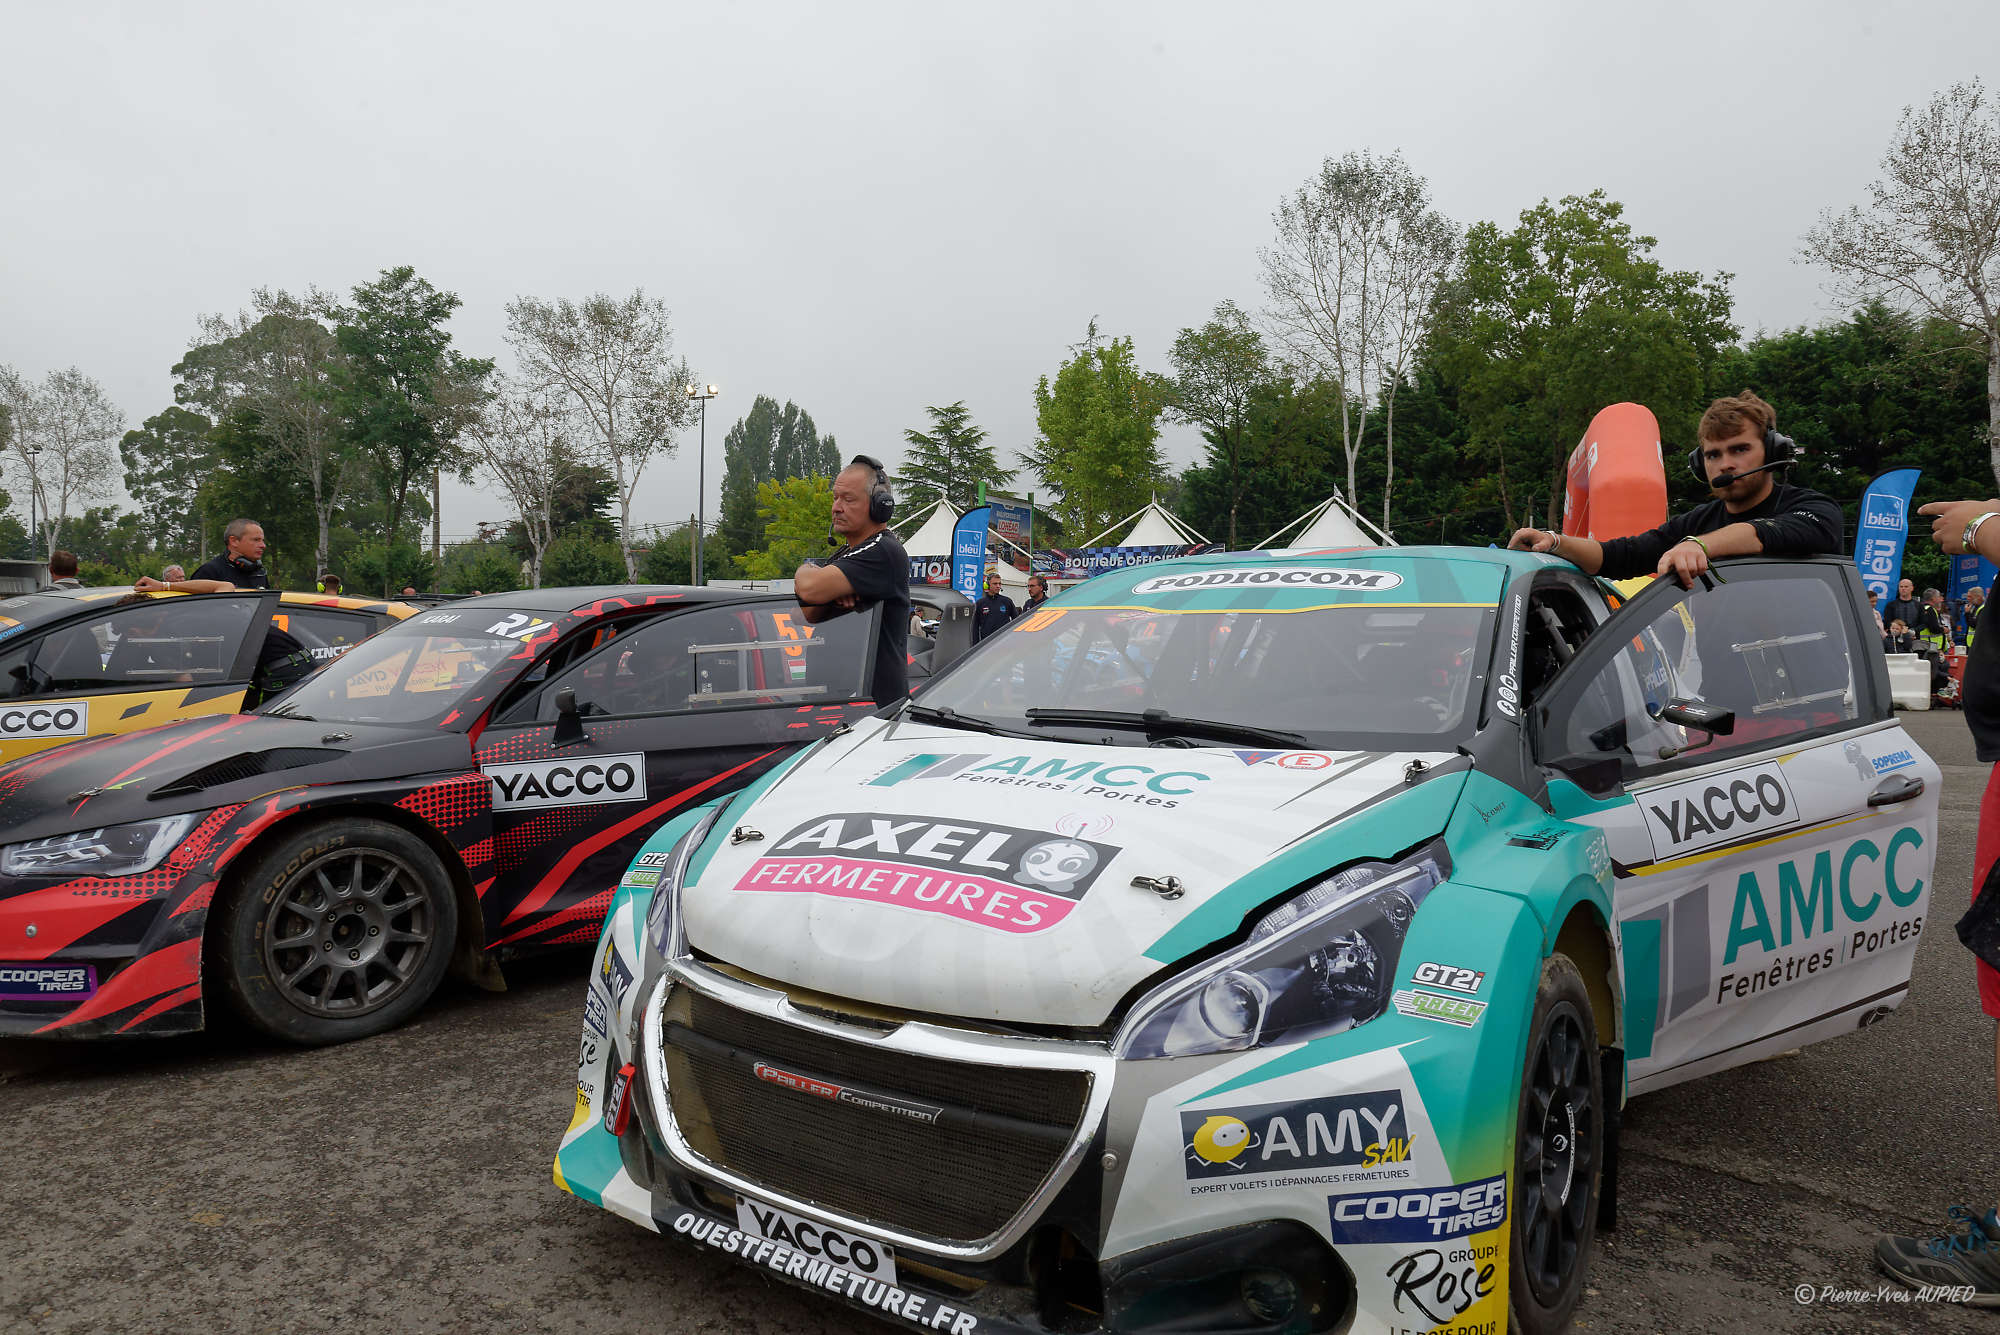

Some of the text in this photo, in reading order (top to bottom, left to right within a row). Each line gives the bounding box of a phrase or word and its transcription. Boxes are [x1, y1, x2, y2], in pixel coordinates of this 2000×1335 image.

[1065, 556, 1123, 568] BOUTIQUE
[1149, 571, 1384, 590] PODIOCOM
[1013, 611, 1068, 632] 10
[0, 708, 79, 736] CCO
[970, 756, 1211, 795] AMCC
[1872, 750, 1913, 769] SOPREMA
[492, 763, 636, 802] YACCO
[953, 773, 1179, 809] Fenêtres Portes
[1650, 773, 1786, 844] YACCO
[775, 819, 1011, 870] AXEL
[750, 863, 1050, 927] FERMETURES
[1722, 826, 1925, 966] AMCC
[0, 969, 86, 982] COOPER
[1415, 962, 1486, 991] GT2i
[1717, 916, 1923, 1005] Fenêtres Portes
[38, 981, 85, 991] TIRES
[1412, 995, 1483, 1018] GREEN
[577, 1080, 594, 1096] OUR
[1261, 1104, 1399, 1161] AMY
[1361, 1134, 1417, 1169] SAV
[1190, 1183, 1228, 1195] EXPERT
[1229, 1179, 1267, 1191] VOLETS
[1275, 1173, 1340, 1187] DÉPANNAGES
[1342, 1169, 1410, 1182] FERMETURES
[1333, 1178, 1506, 1222] COOPER
[1428, 1202, 1504, 1236] TIRES
[748, 1203, 880, 1274] YACCO
[1448, 1245, 1498, 1263] GROUPE
[673, 1212, 978, 1335] OUESTFERMETURE.FR
[1386, 1249, 1497, 1325] Rose
